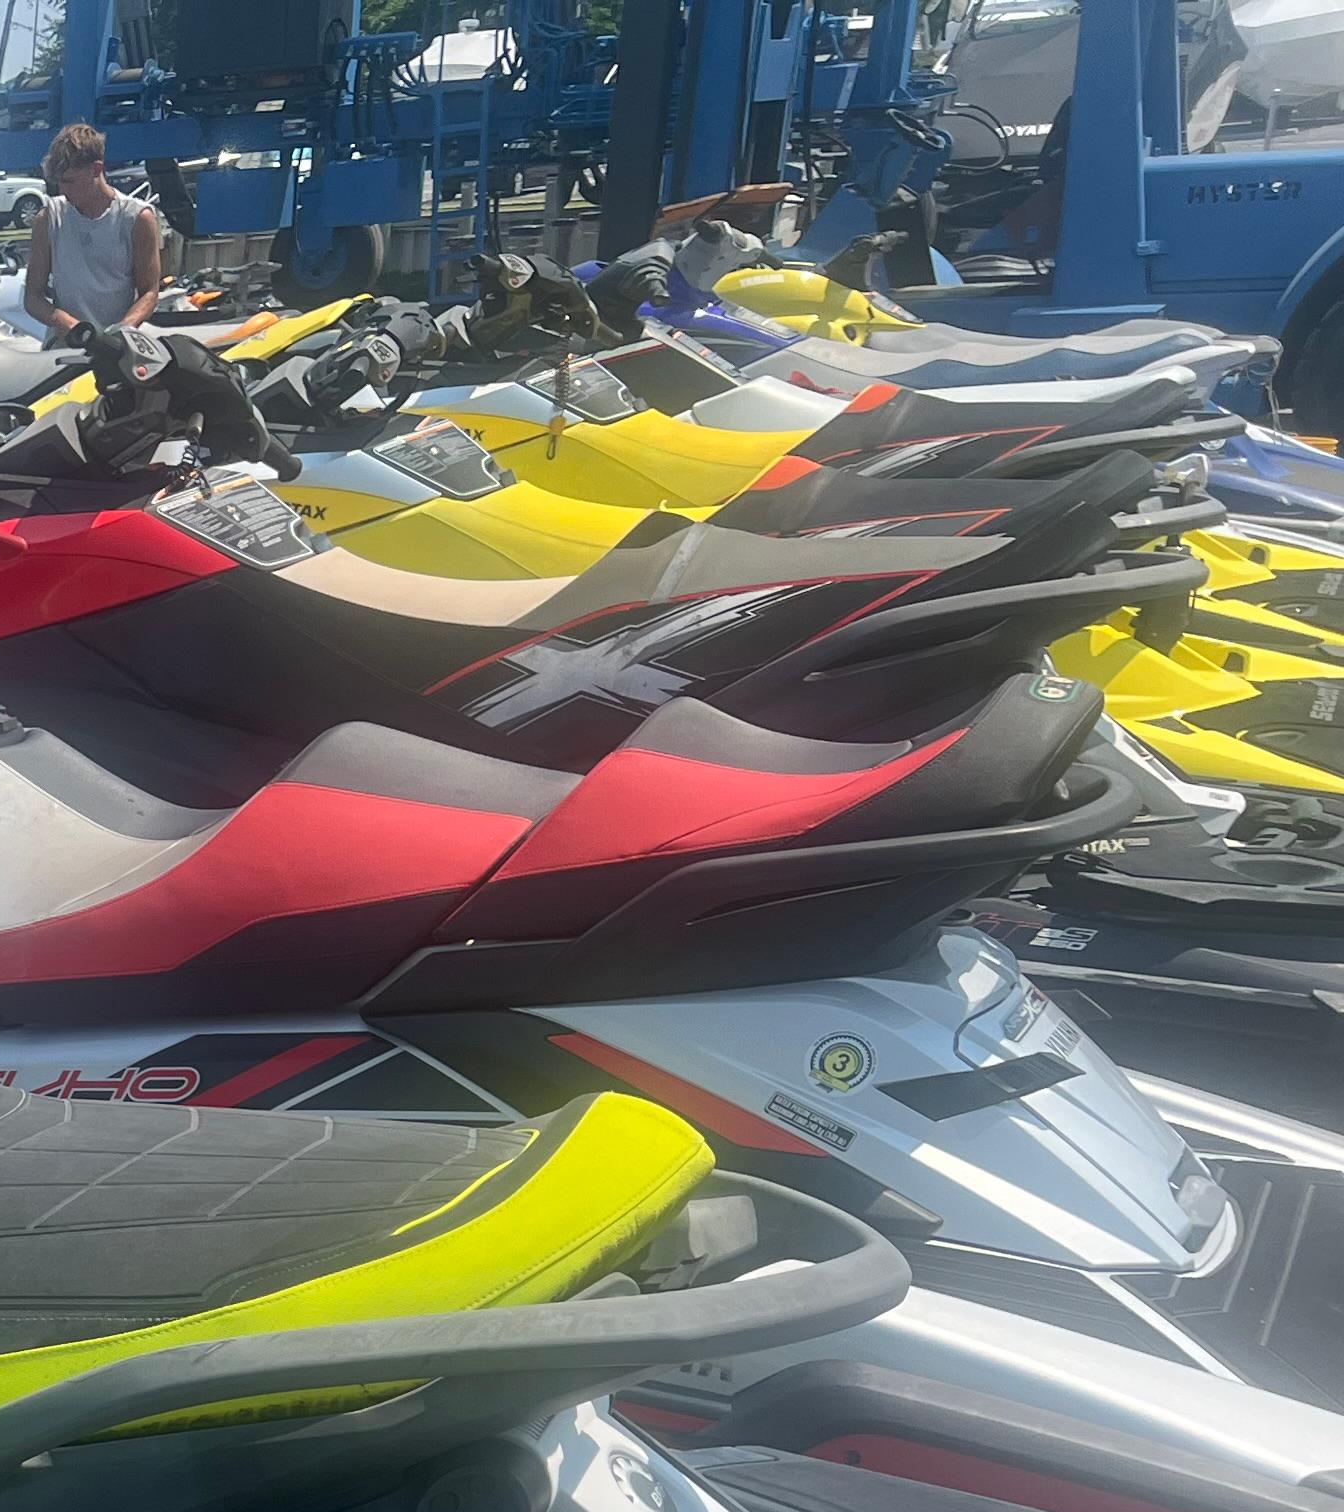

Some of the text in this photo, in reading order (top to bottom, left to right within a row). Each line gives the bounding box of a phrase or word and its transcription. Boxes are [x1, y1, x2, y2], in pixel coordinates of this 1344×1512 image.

[1187, 180, 1303, 206] HYSTER
[284, 501, 327, 521] TAX
[1080, 837, 1128, 854] TAX
[832, 1053, 851, 1073] 3
